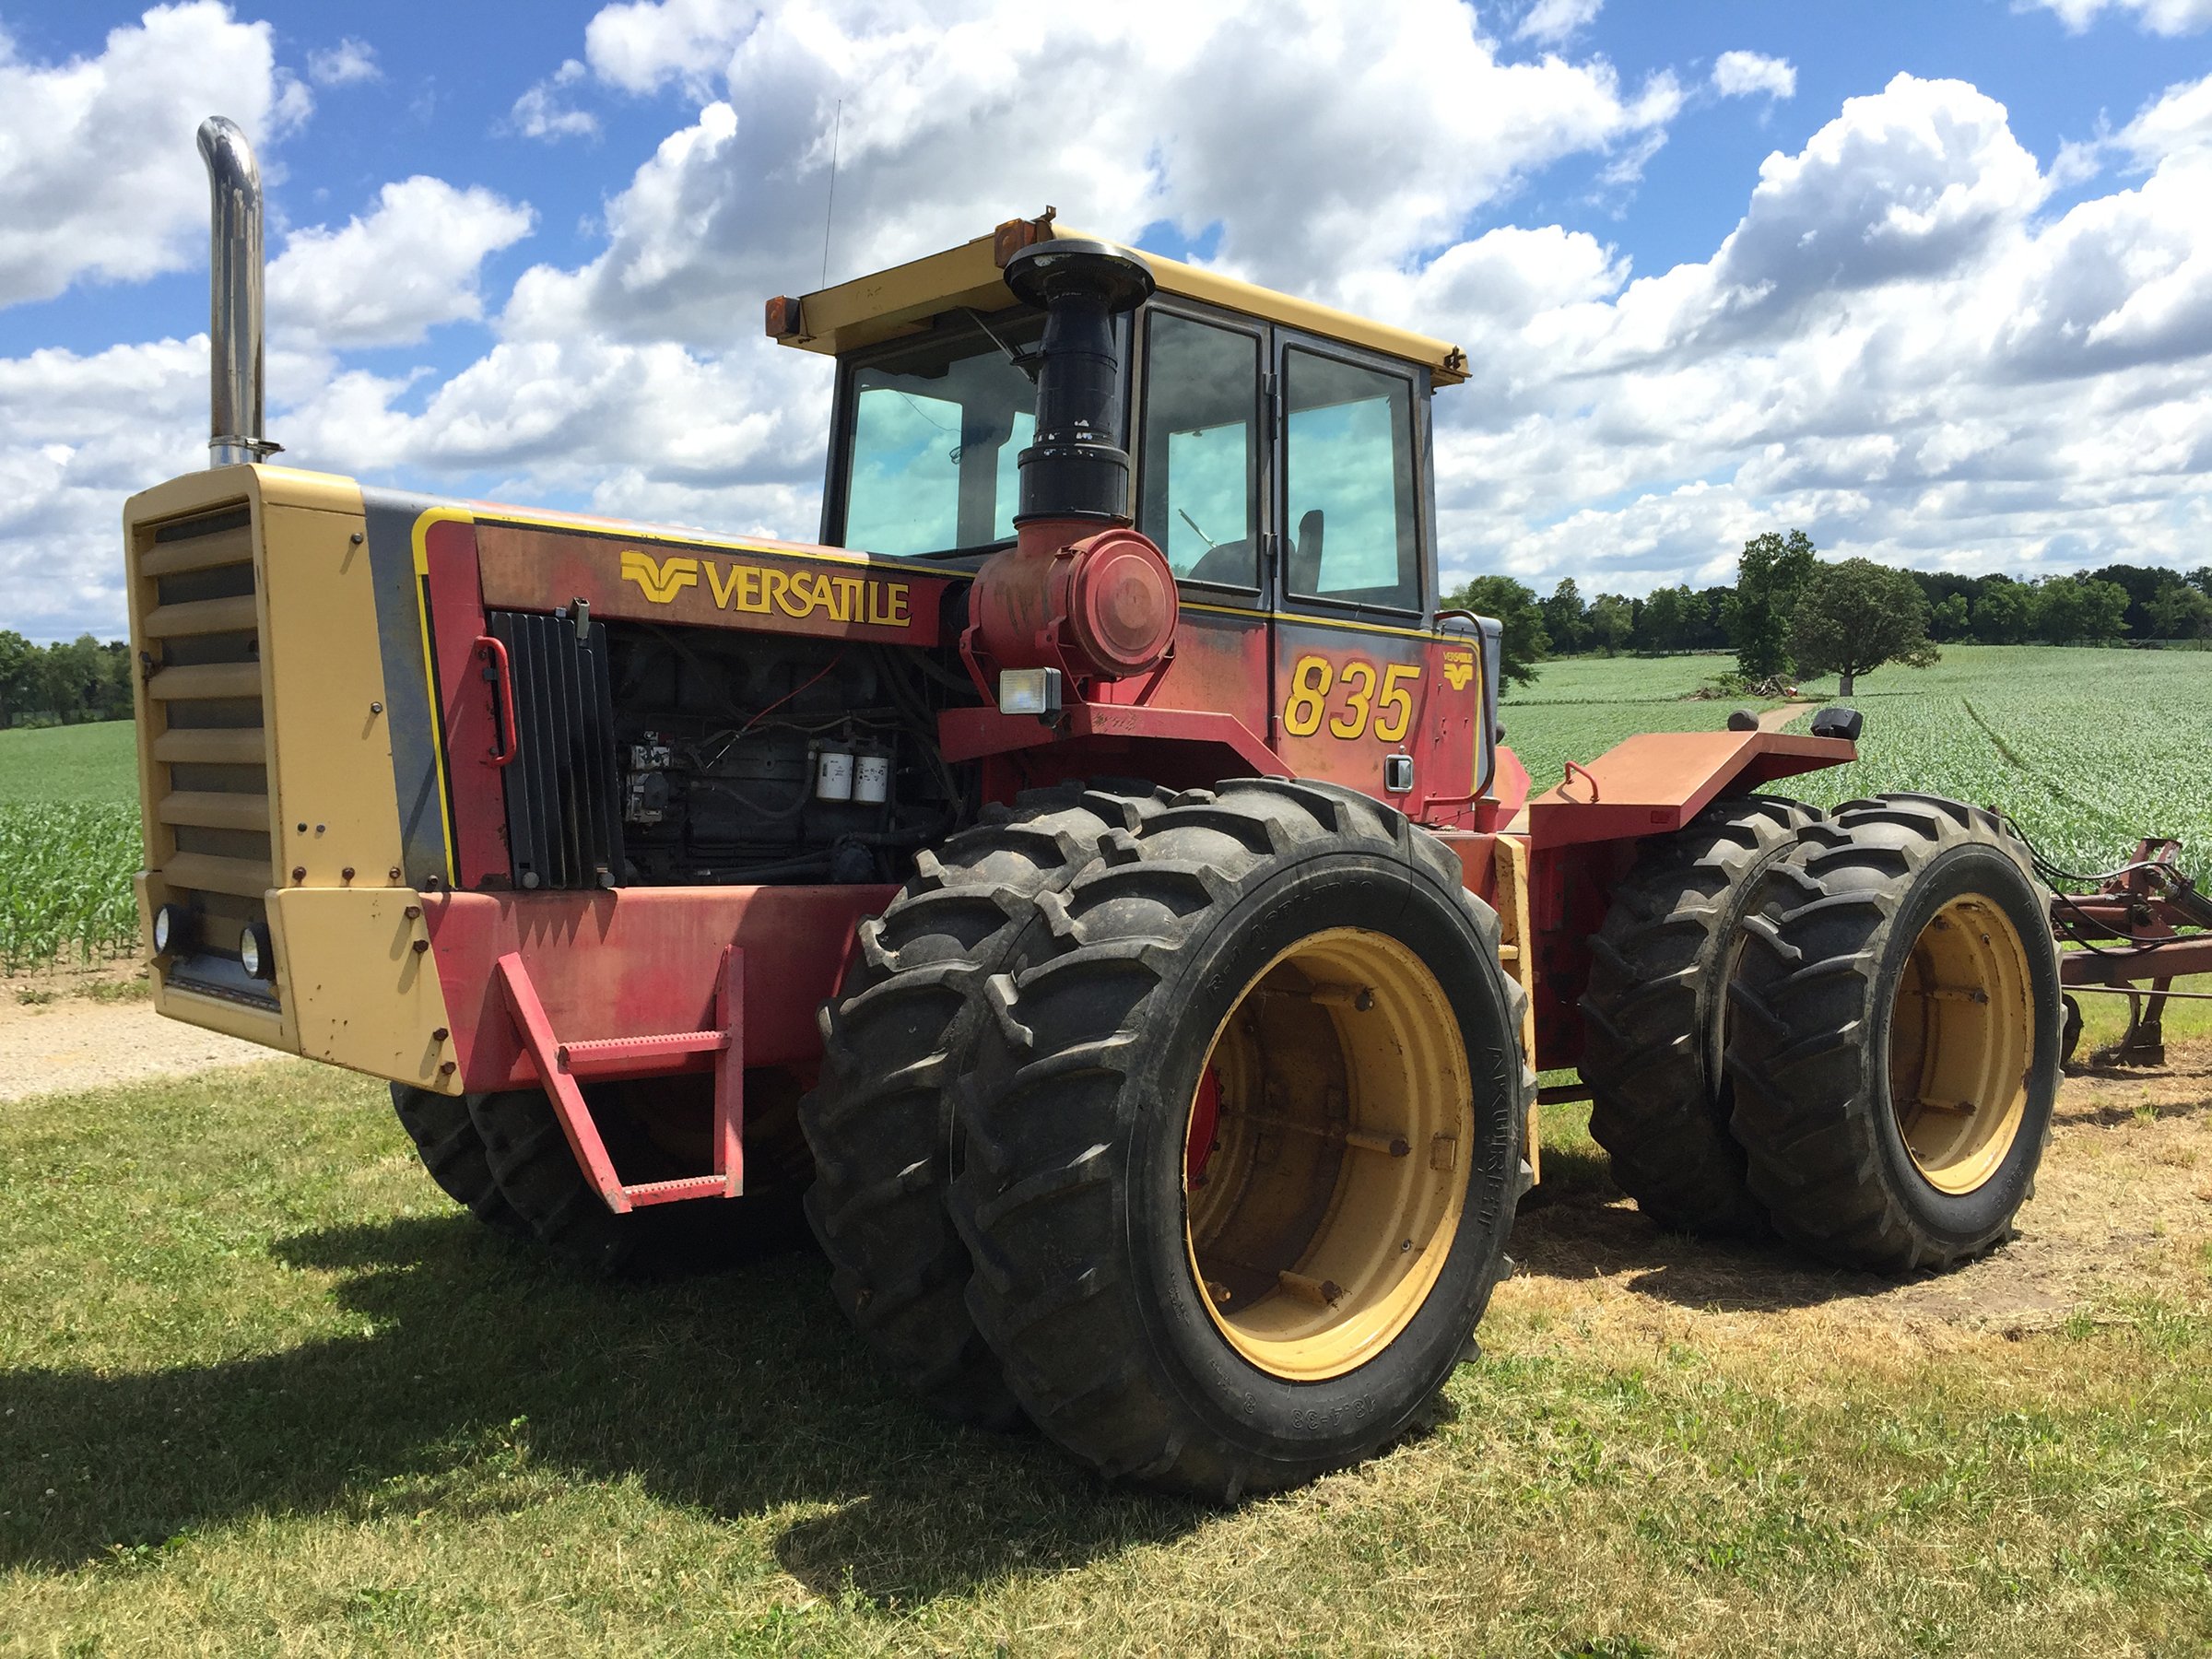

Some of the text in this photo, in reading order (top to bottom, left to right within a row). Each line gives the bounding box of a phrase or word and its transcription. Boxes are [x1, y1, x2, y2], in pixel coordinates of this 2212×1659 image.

[700, 560, 912, 628] VERSATILE
[1283, 655, 1421, 743] 835
[1291, 1394, 1376, 1430] 18.4-38
